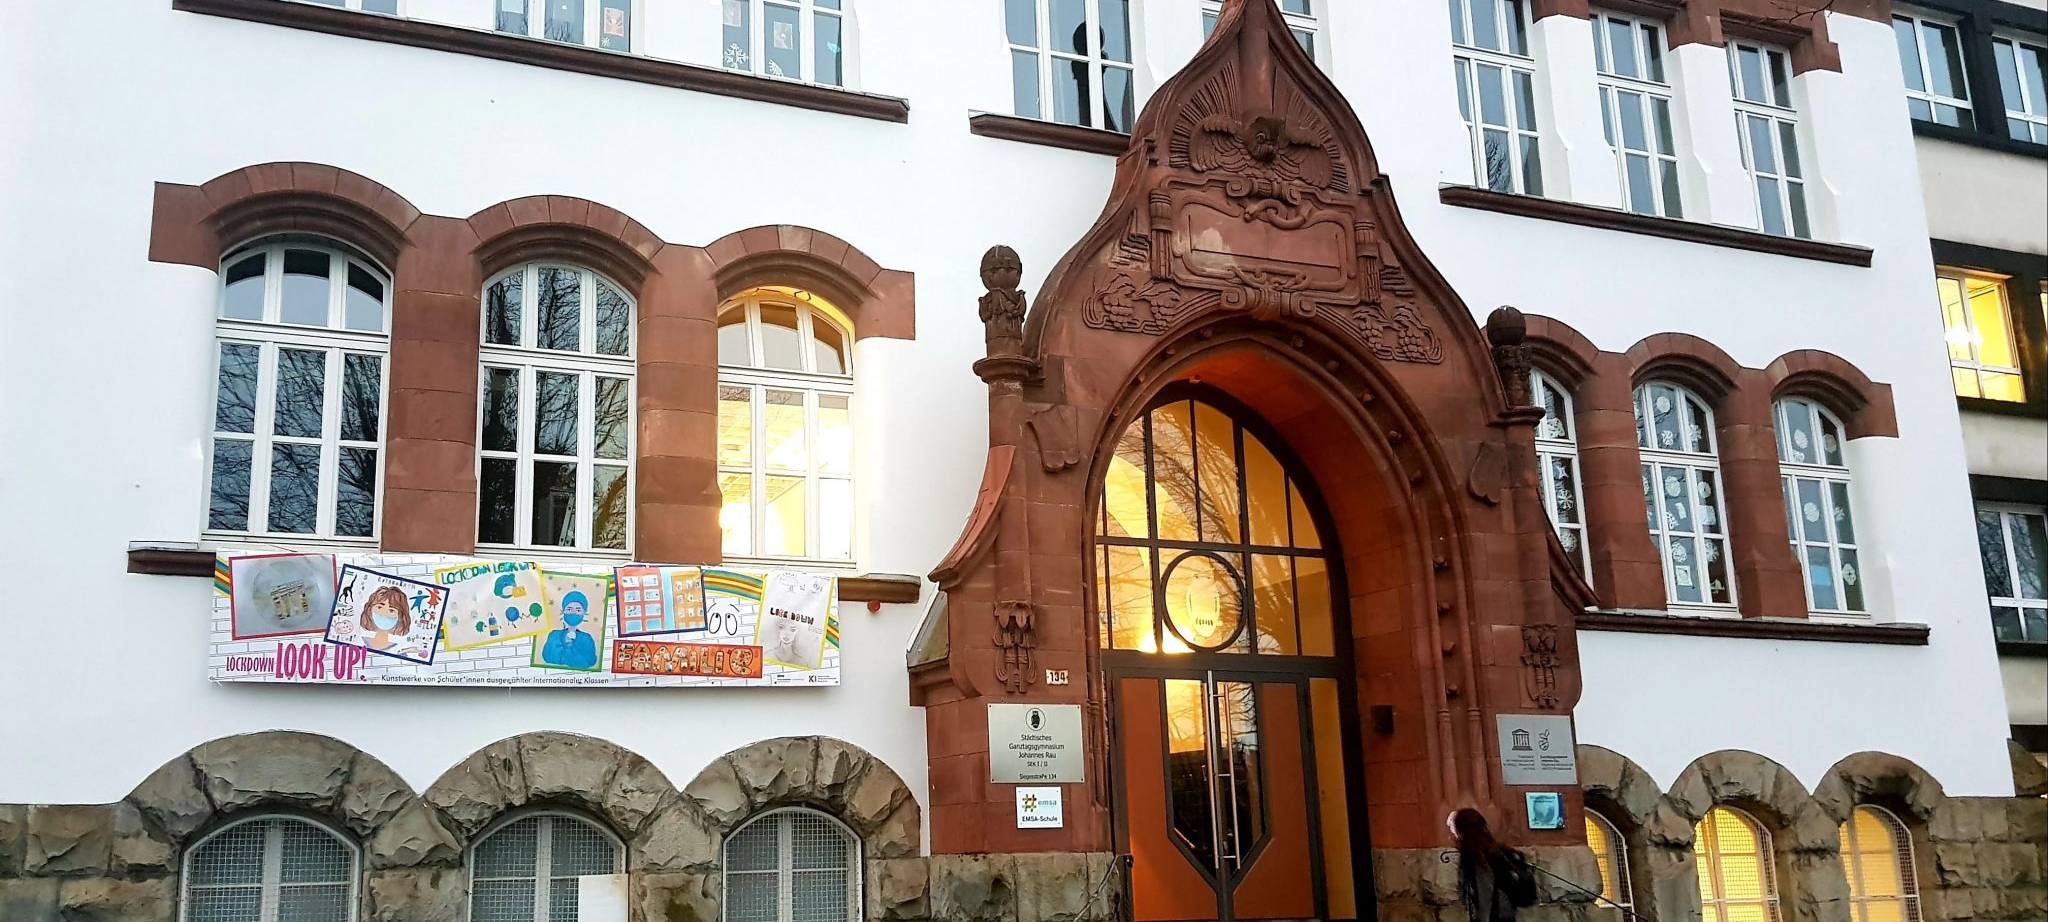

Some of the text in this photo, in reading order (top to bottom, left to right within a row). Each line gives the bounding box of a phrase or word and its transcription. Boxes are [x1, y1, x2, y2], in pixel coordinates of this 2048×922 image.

[226, 642, 367, 681] LOCKDOWN LOOK UP!
[381, 674, 421, 682] Kunstwerke
[808, 675, 817, 683] KI
[1049, 671, 1065, 682] 134
[1008, 743, 1065, 751] Ganztagsgymnasium
